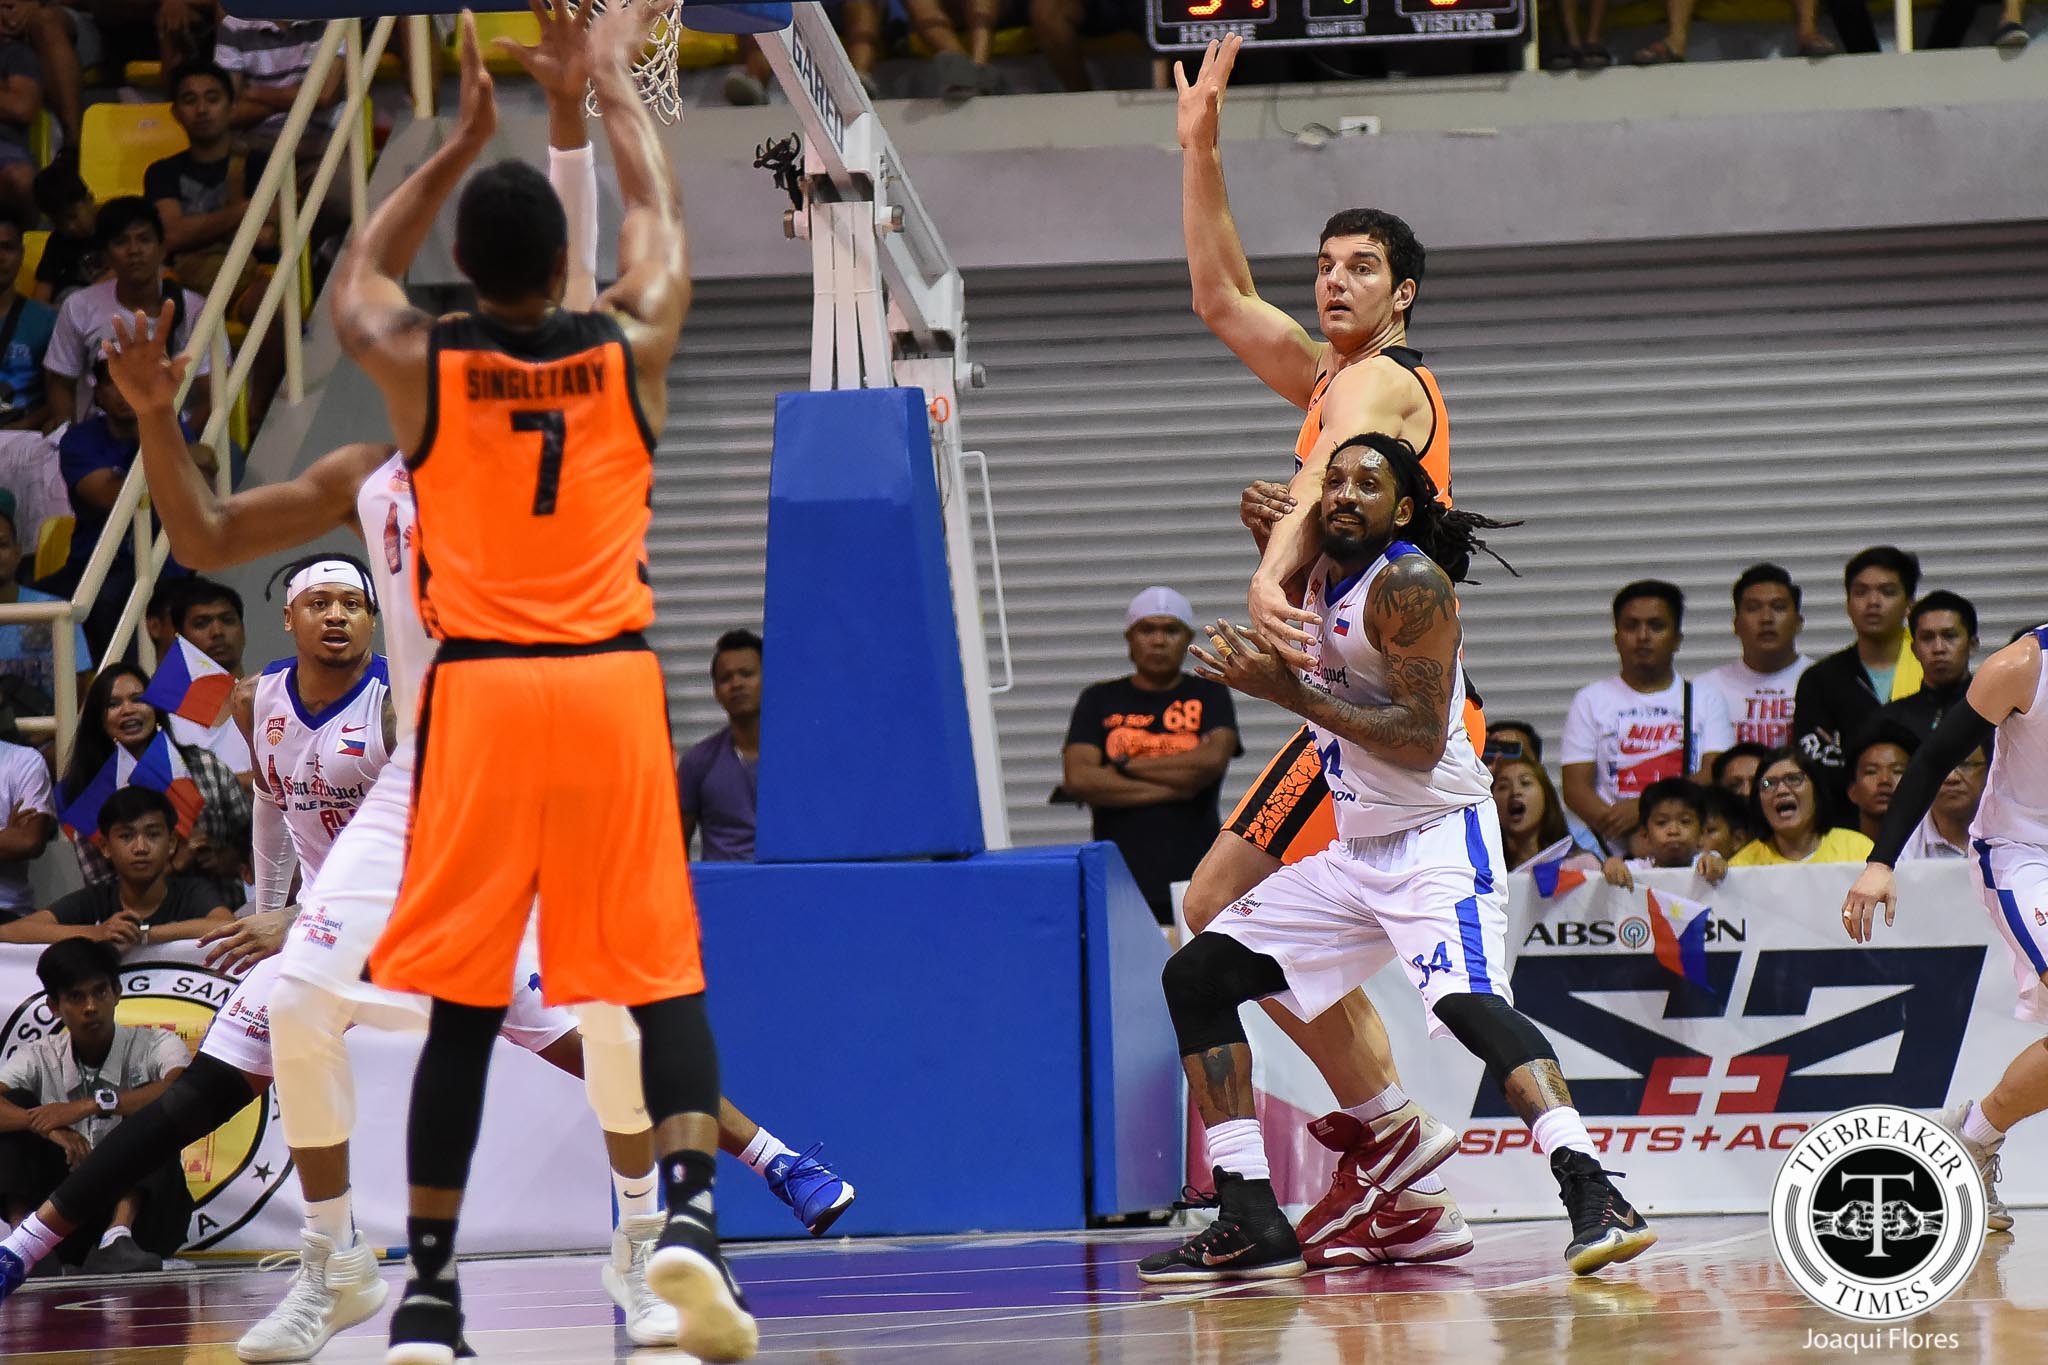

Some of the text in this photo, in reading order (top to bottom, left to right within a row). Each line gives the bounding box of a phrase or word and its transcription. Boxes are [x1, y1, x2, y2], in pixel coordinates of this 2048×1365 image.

[1178, 23, 1257, 43] HOME
[1409, 12, 1496, 33] VISITOR
[793, 19, 844, 154] GARED
[467, 362, 606, 401] SINGLETARY
[509, 410, 567, 517] 7
[1162, 698, 1203, 733] 68
[1745, 697, 1796, 720] THE
[268, 719, 286, 729] ABL
[1627, 723, 1684, 742] NIKE
[283, 775, 310, 797] San
[1523, 920, 1617, 948] ABS
[1411, 941, 1453, 990] 34
[1459, 1122, 1814, 1156] SPRTS+AC
